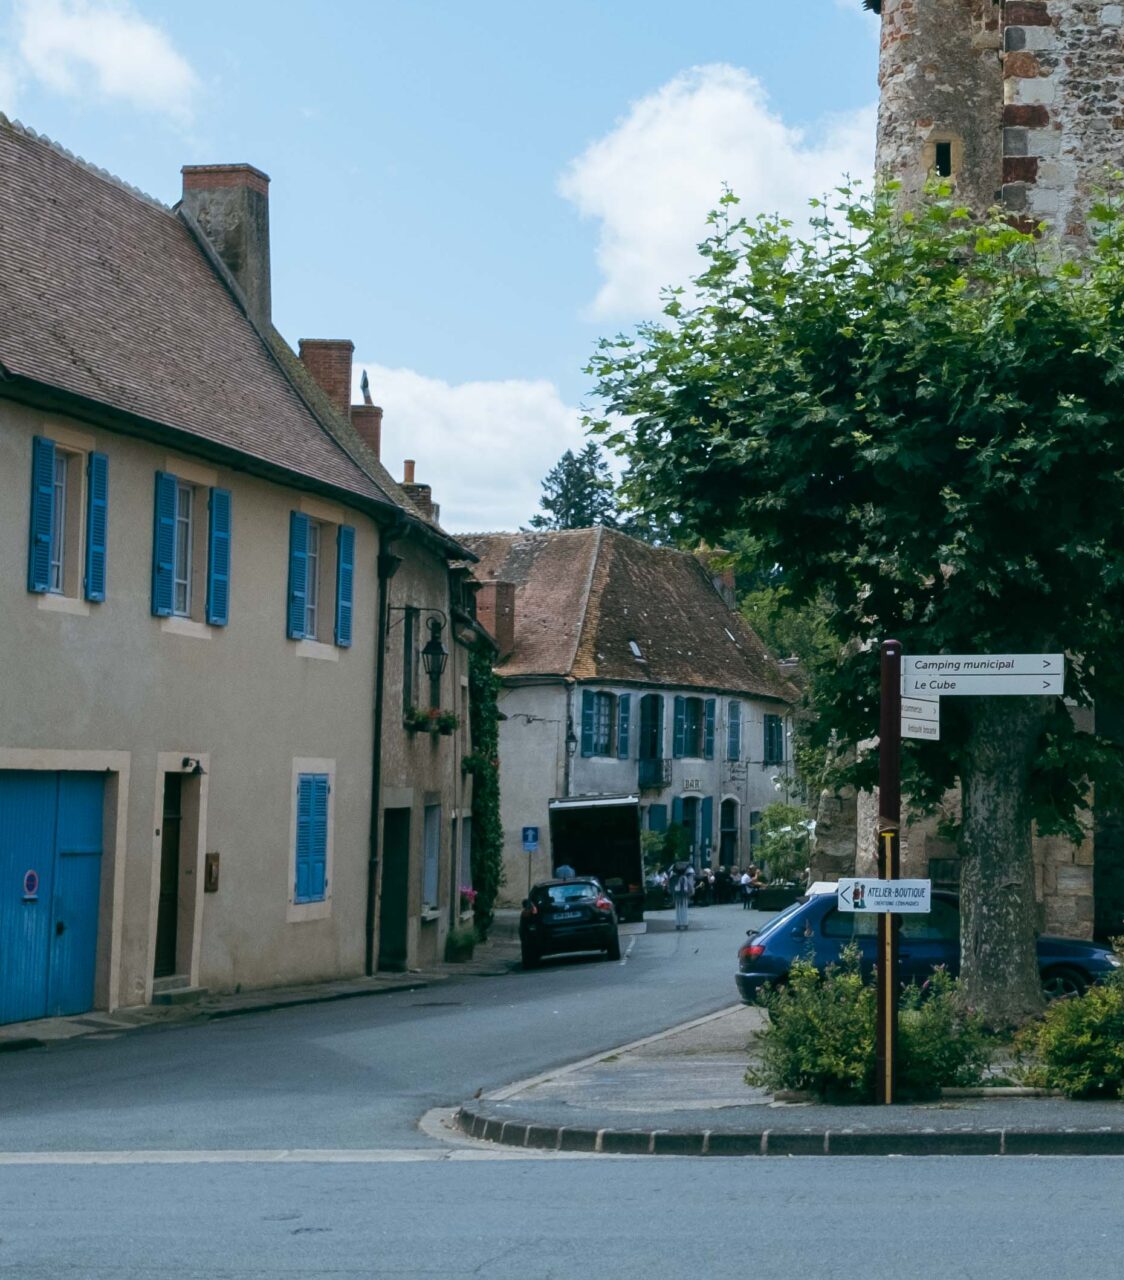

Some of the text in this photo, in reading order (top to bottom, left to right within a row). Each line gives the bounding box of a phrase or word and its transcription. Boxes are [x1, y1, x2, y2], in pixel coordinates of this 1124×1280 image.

[914, 659, 1015, 671] Camping municipal
[914, 680, 957, 690] Le Cube
[685, 779, 700, 789] BAR
[867, 887, 926, 898] ATELIER-BOUTIQUE
